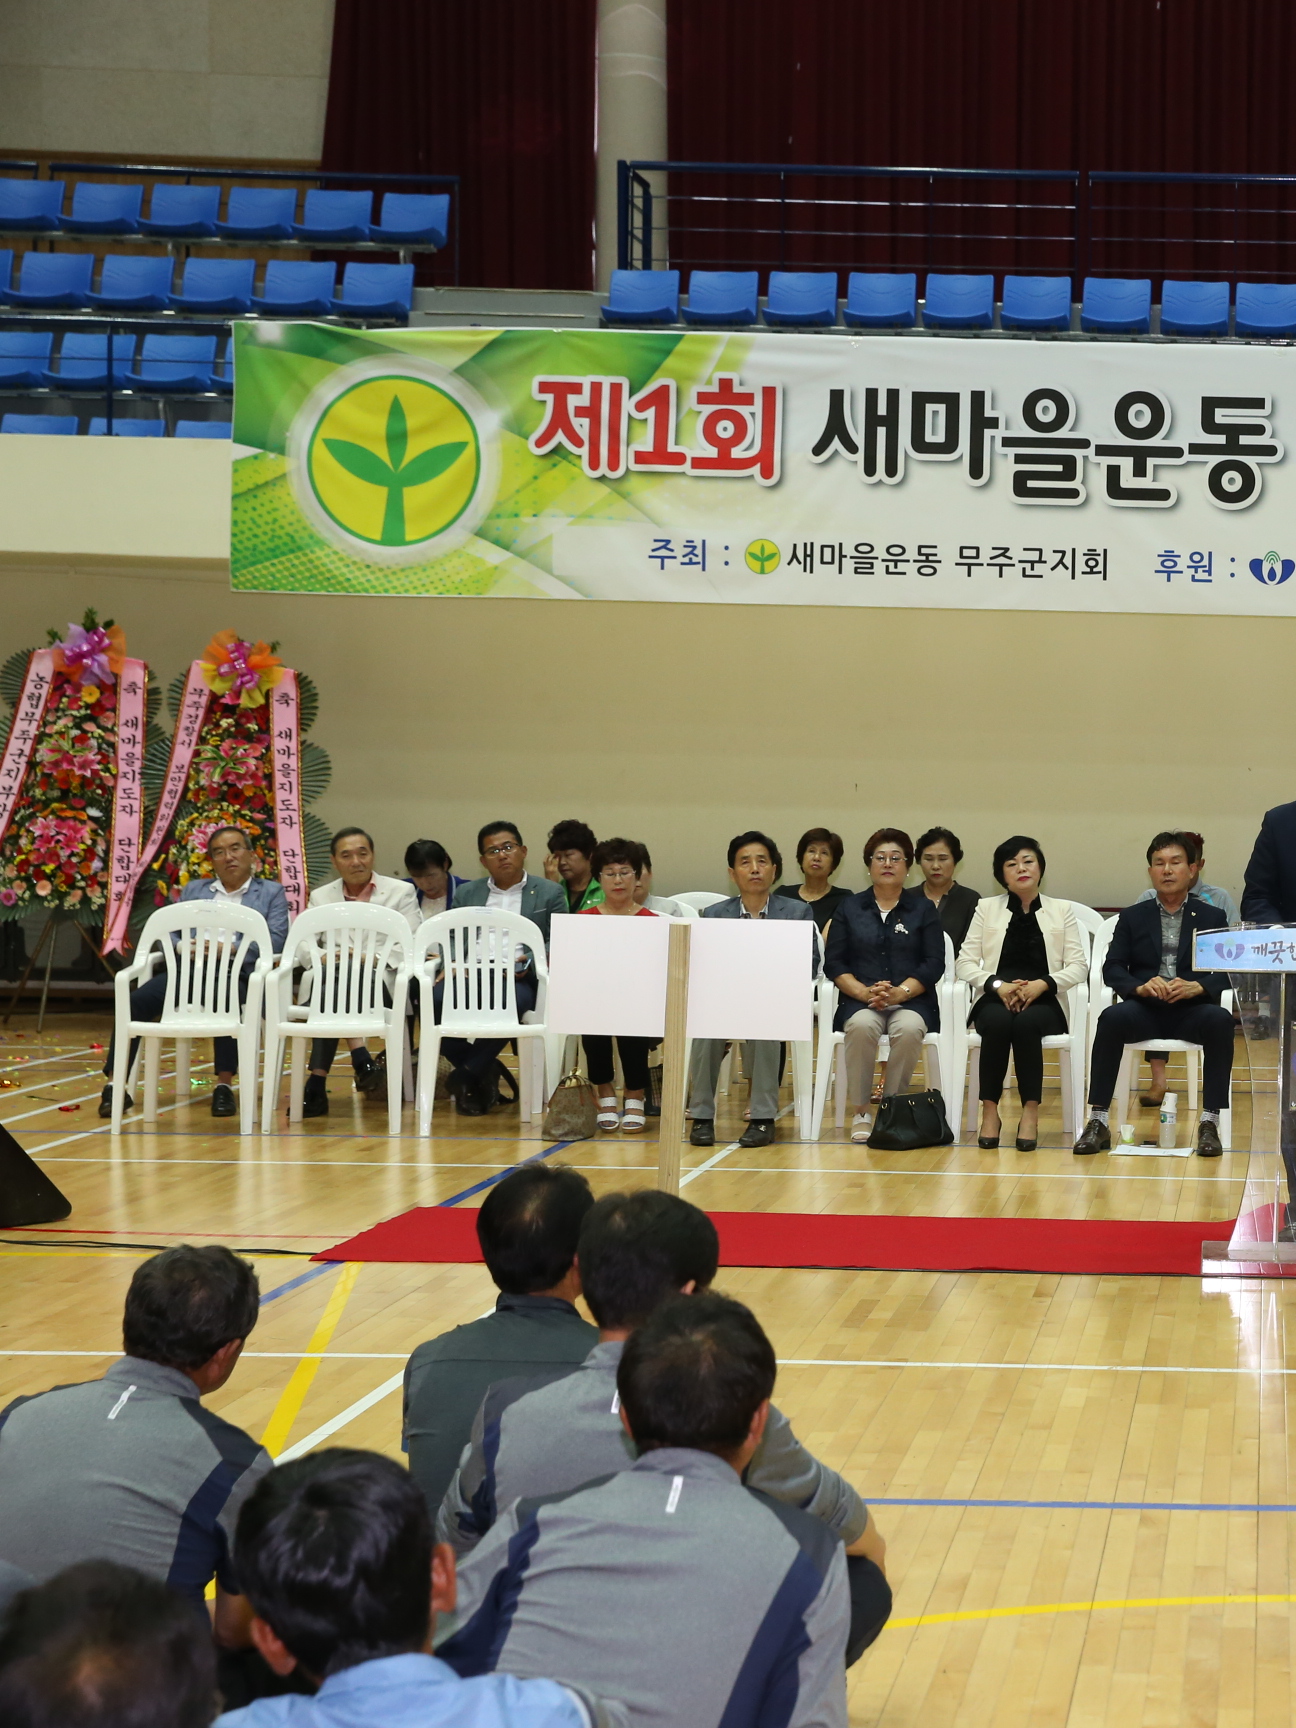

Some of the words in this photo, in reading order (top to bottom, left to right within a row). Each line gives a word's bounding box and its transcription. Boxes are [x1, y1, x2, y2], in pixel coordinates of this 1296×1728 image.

[535, 378, 776, 480] 제1회
[811, 387, 1278, 504] 새마을운동
[648, 539, 707, 572] 주최
[786, 541, 942, 577] 새마을운동
[954, 545, 1108, 581] 무주군지회
[1155, 549, 1213, 583] 후원
[118, 716, 140, 818] 새마을지도자
[275, 727, 298, 830] 새마을지도자
